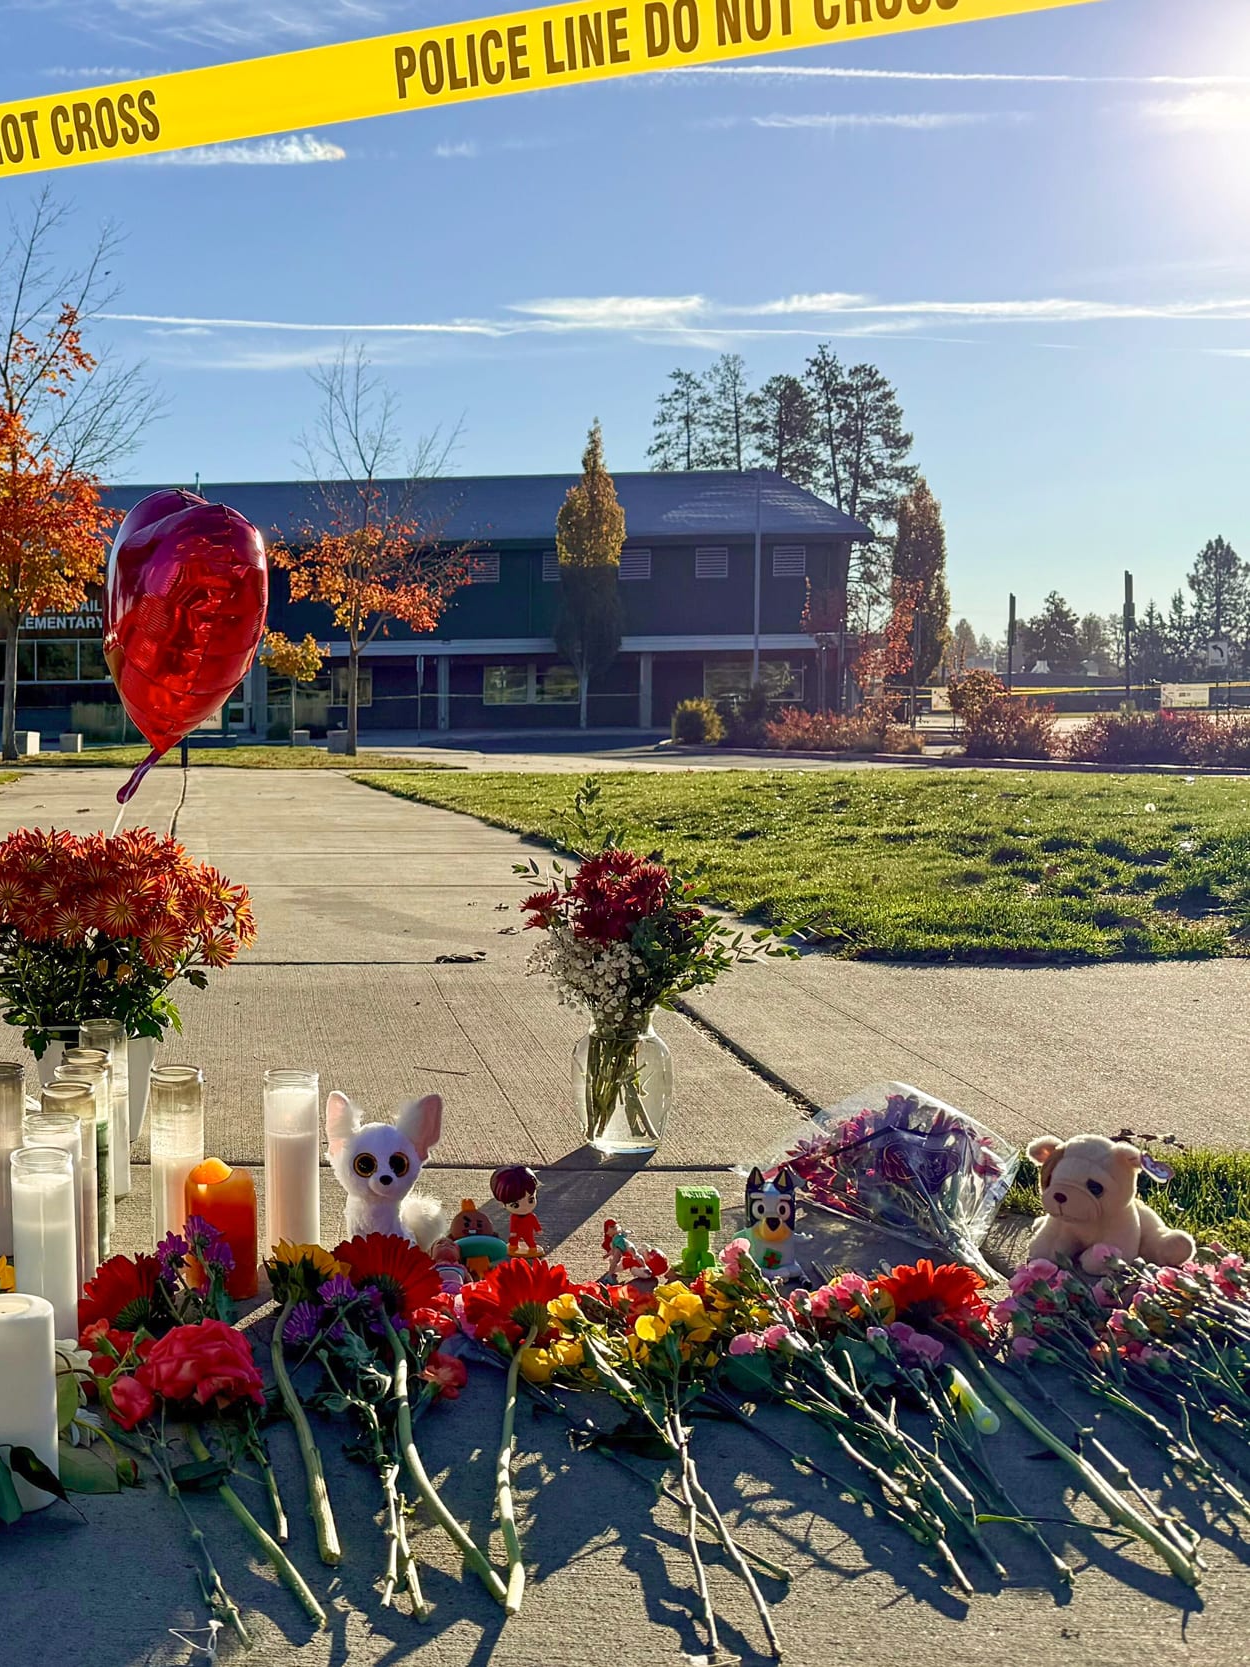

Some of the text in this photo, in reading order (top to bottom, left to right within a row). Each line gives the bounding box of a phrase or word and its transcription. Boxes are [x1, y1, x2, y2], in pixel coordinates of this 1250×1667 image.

[395, 25, 530, 99] POLICE
[544, 8, 630, 74] LINE
[645, 0, 698, 57] DO
[51, 90, 159, 155] CROSS
[18, 616, 103, 630] LEMENTARY
[78, 599, 103, 613] AIL
